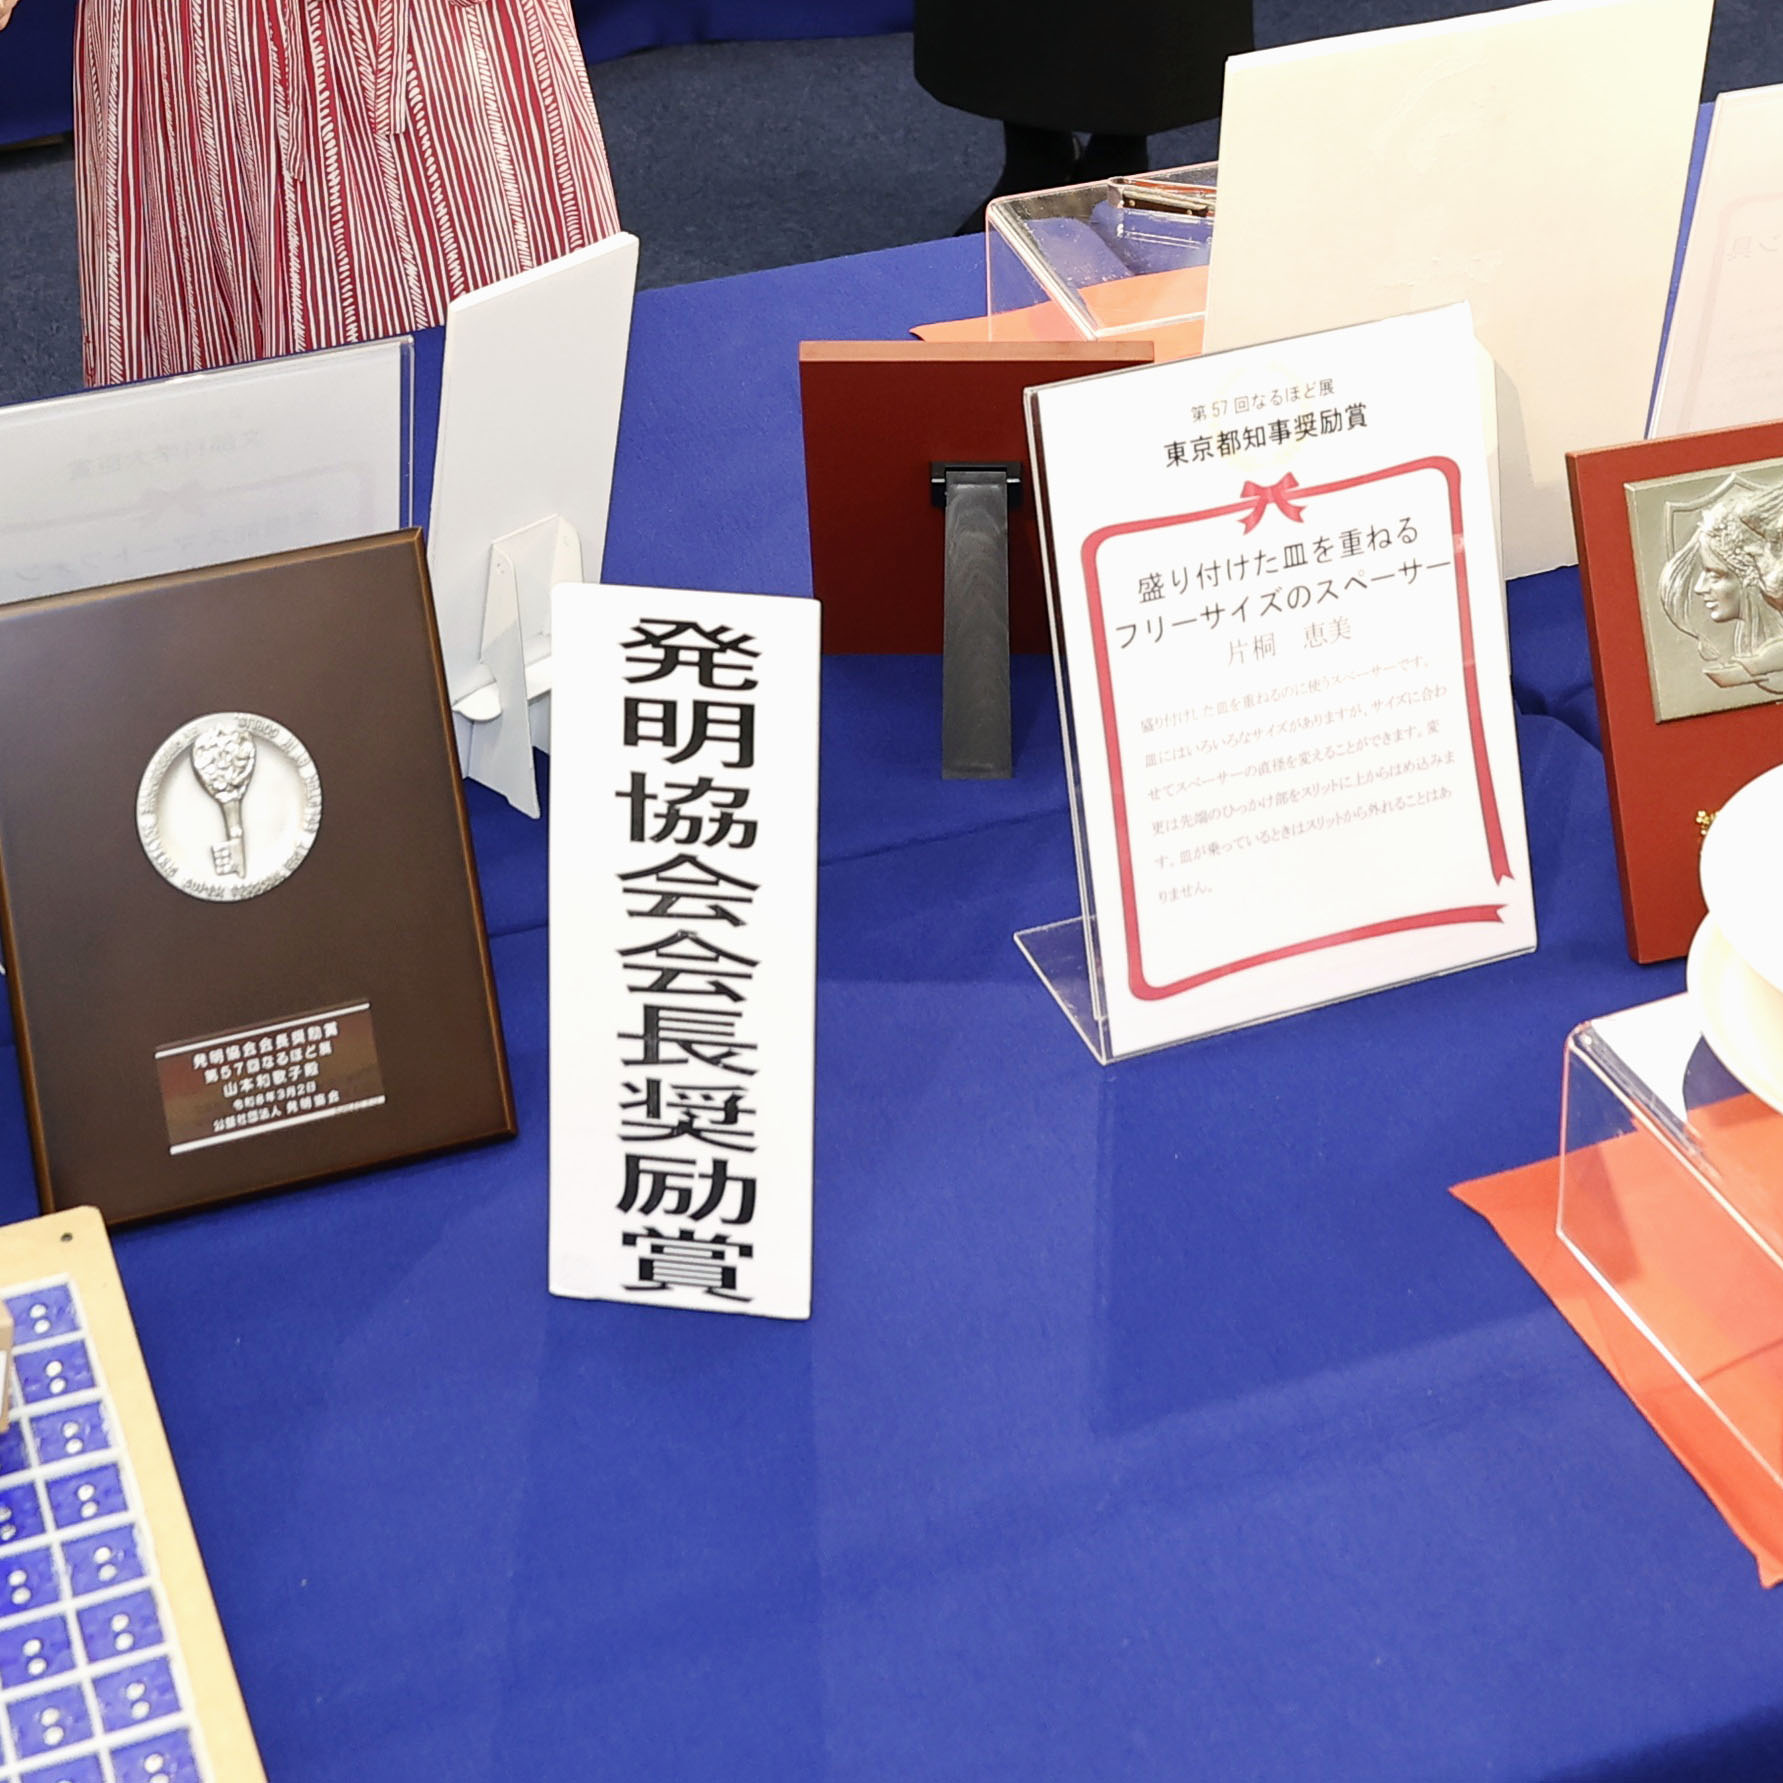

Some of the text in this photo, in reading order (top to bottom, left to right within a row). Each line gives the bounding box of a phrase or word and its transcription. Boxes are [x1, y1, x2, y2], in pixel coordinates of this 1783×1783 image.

[1163, 403, 1369, 470] 東京都知事奨励賞
[1190, 377, 1336, 424] 第57回なるほど展
[1137, 515, 1420, 606] 盛り付けた皿を重ねる
[1114, 559, 1453, 651] フリーサイズのスペーサー
[1226, 616, 1353, 667] 片桐 恵美
[615, 616, 760, 1302] 発明協会会長奨励賞
